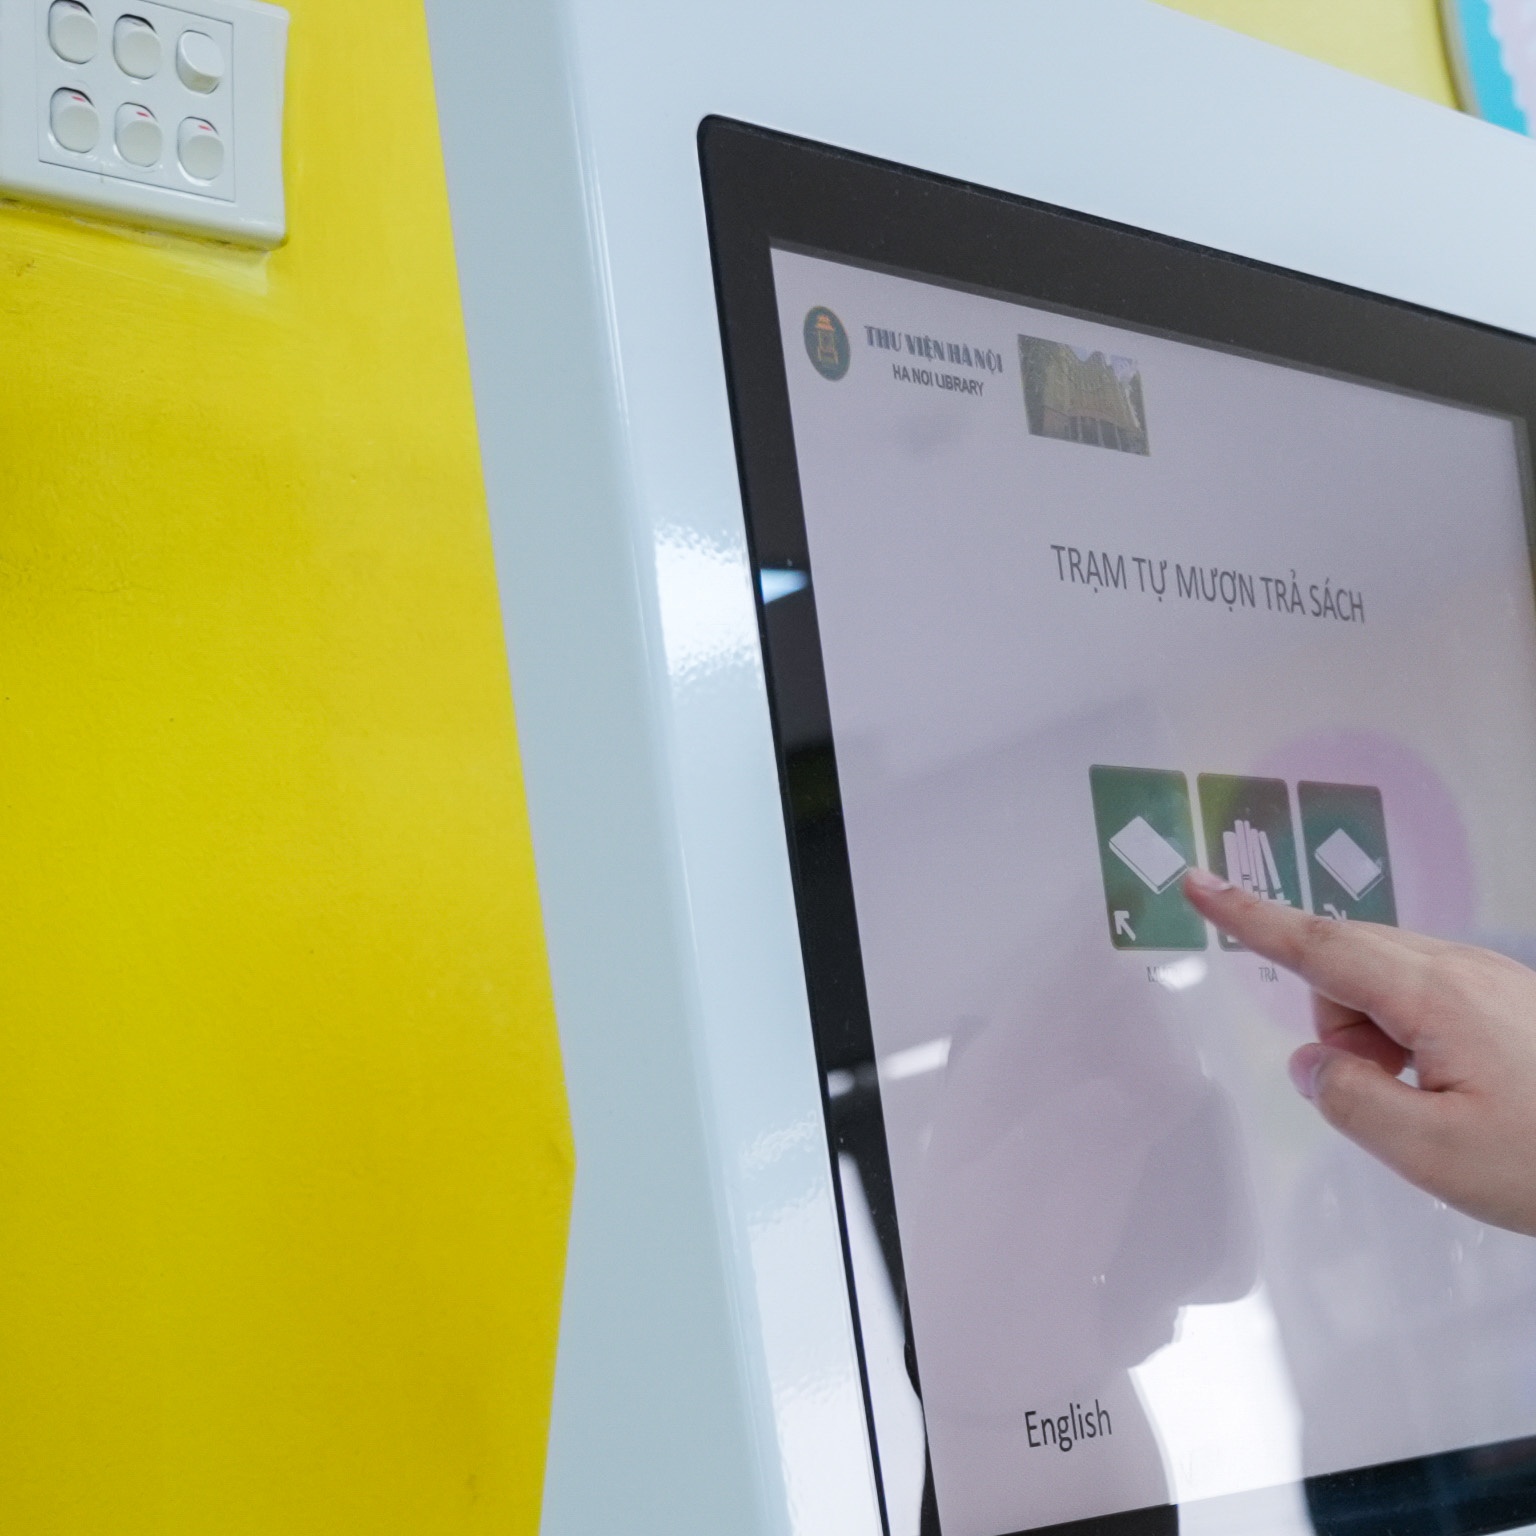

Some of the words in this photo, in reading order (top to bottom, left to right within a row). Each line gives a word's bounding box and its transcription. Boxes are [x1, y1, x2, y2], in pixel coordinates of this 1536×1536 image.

[892, 364, 911, 383] HA
[912, 367, 934, 387] NOI
[935, 373, 984, 397] LIBRARY
[1050, 545, 1127, 593] TRẠM
[1132, 556, 1168, 602] TỰ
[1175, 564, 1256, 612] MƯỢN
[1259, 569, 1305, 615] TRẢ
[1309, 577, 1365, 623] SÁCH
[1025, 1399, 1112, 1452] English
